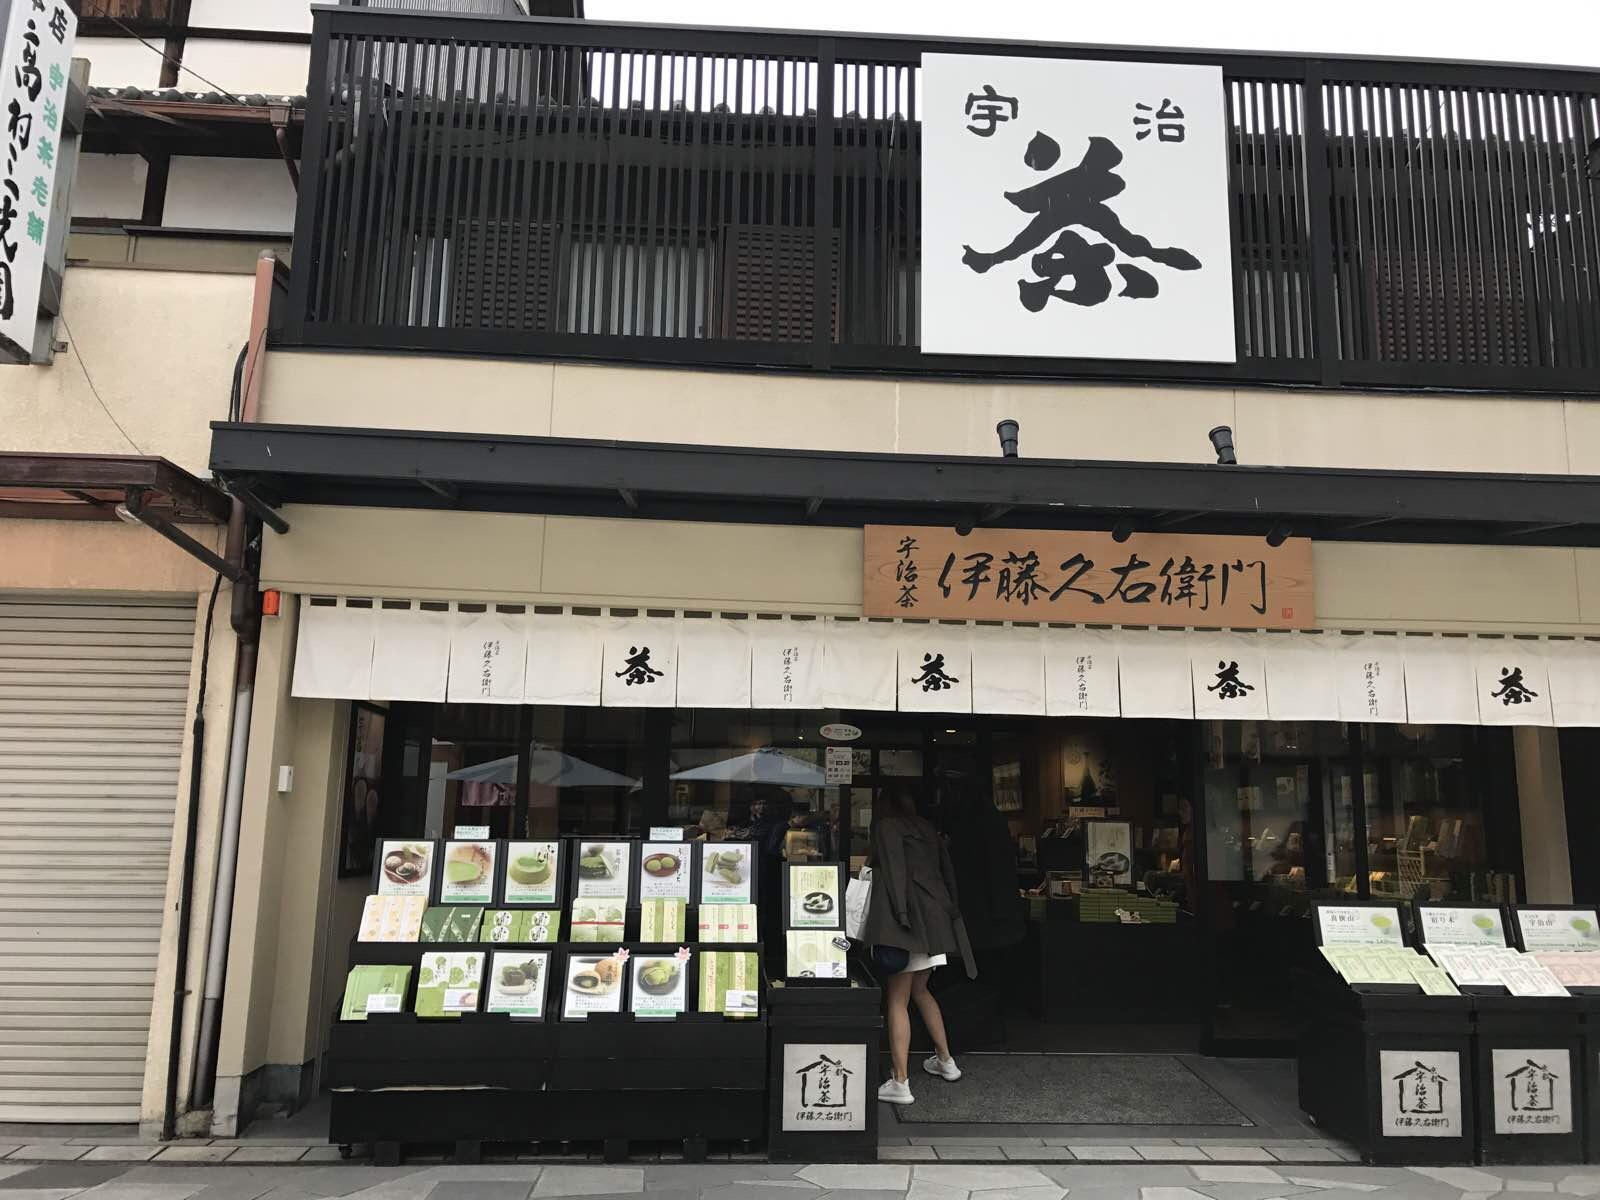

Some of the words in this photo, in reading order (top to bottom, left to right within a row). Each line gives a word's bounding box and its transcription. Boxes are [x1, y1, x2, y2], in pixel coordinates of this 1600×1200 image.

[27, 62, 65, 246] 宇治茶老舗
[962, 130, 1202, 313] 茶
[895, 535, 920, 609] 宇治茶
[937, 550, 1267, 615] 伊藤久右衛門
[615, 646, 664, 686] 茶
[911, 652, 960, 692] 茶
[1207, 660, 1256, 700] 茶
[1491, 667, 1539, 706] 茶
[818, 1064, 831, 1104] 宇治茶
[1415, 1070, 1428, 1110] 宇治茶
[1526, 1068, 1538, 1107] 宇治茶
[796, 1111, 853, 1121] 伊藤久右衛門
[1395, 1117, 1449, 1128] 伊藤久右衛門
[1507, 1115, 1560, 1125] 伊藤久右衛門
